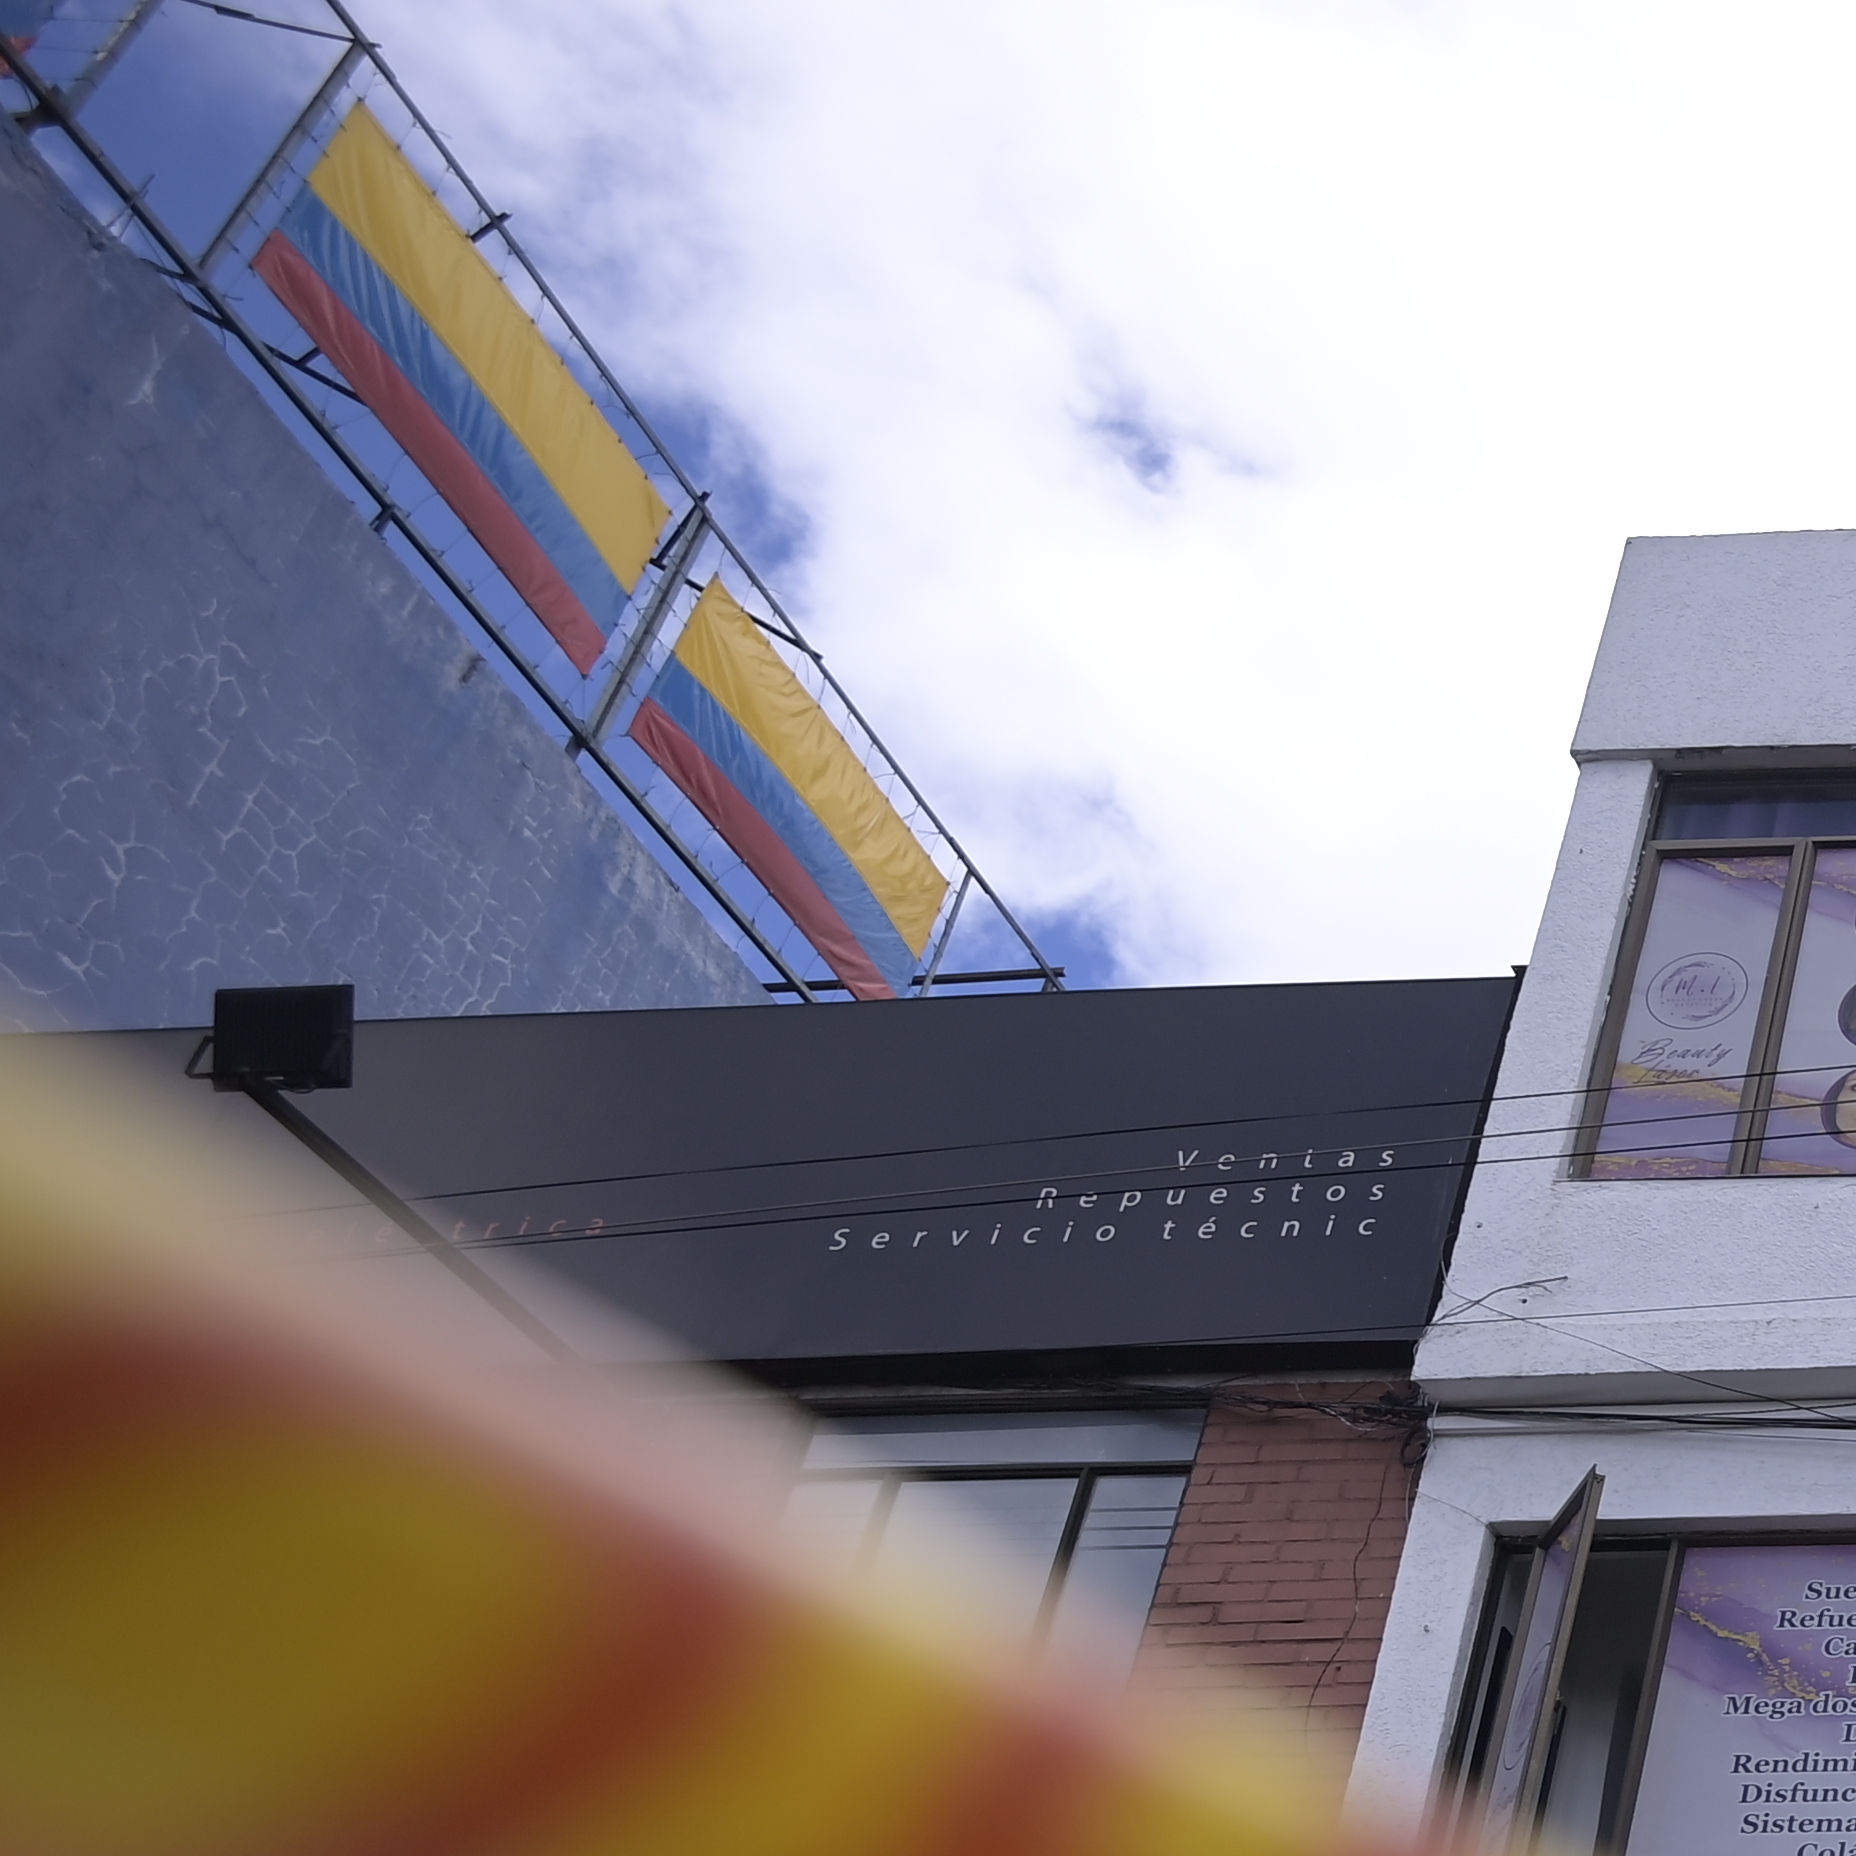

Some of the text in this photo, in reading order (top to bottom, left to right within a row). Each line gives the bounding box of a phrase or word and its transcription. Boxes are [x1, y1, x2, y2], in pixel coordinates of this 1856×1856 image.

[1036, 1183, 1384, 1212] Repuestos
[829, 1221, 1116, 1251] Servicio
[1724, 1695, 1802, 1719] Mega
